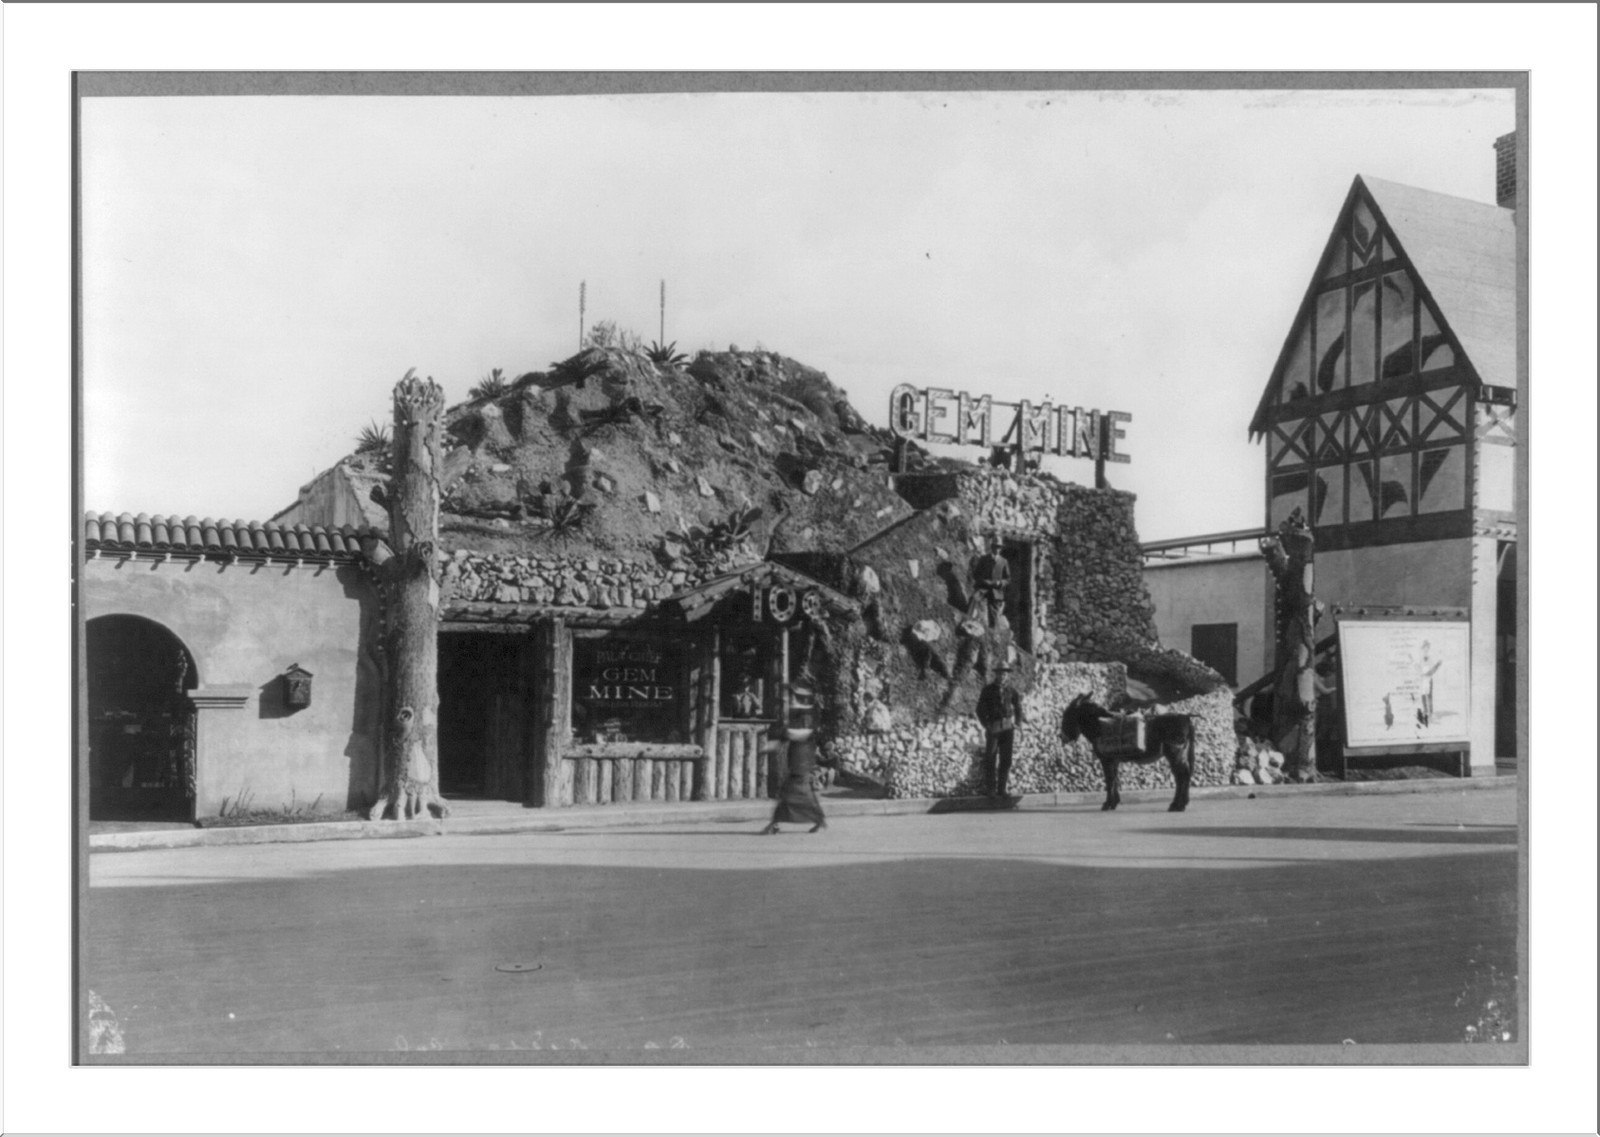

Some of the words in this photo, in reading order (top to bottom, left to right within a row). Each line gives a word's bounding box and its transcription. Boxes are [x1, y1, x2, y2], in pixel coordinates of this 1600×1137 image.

[890, 383, 992, 448] GEM
[1019, 399, 1133, 464] MINE
[602, 668, 656, 682] GEM
[590, 685, 673, 699] MINE
